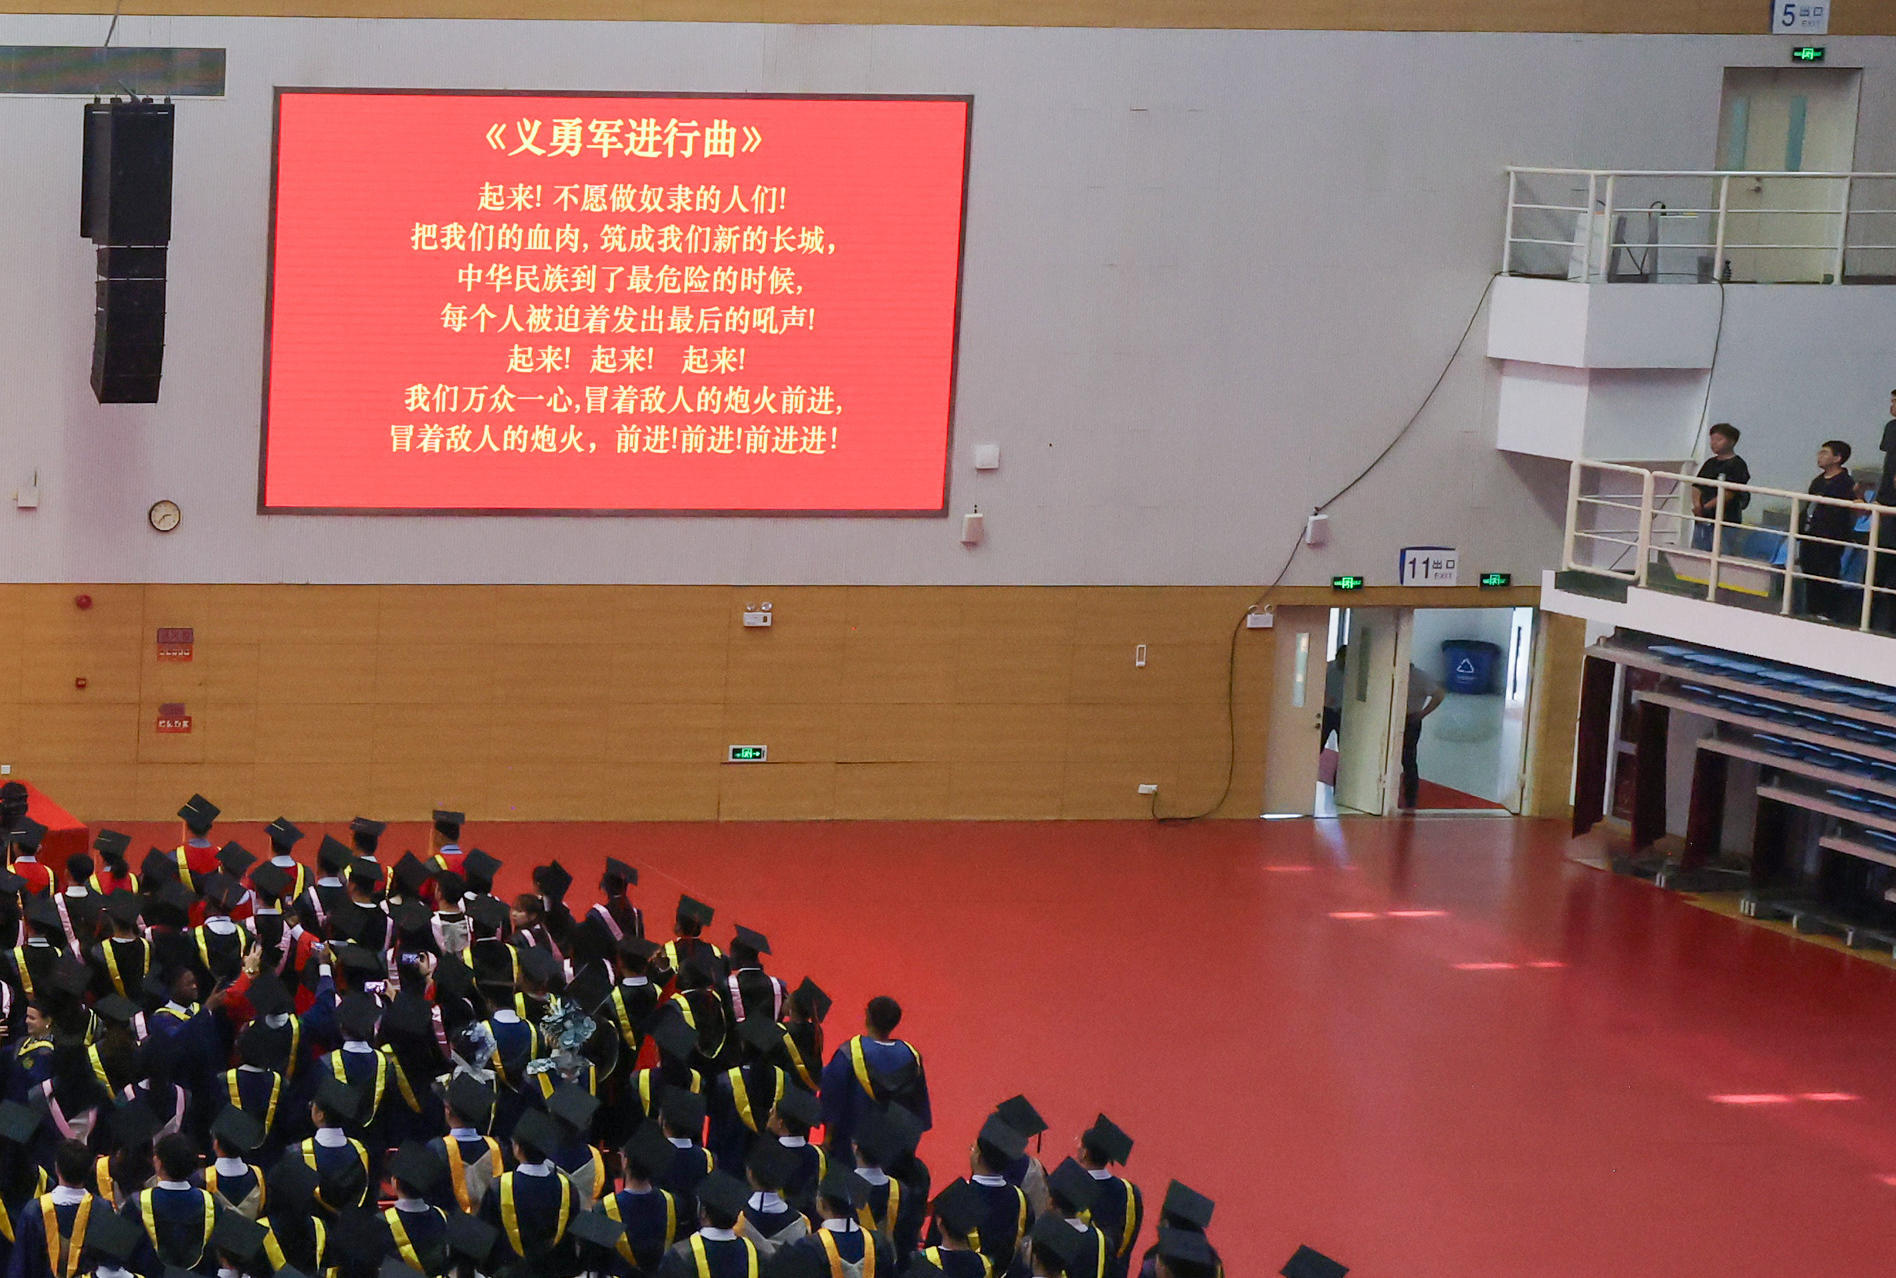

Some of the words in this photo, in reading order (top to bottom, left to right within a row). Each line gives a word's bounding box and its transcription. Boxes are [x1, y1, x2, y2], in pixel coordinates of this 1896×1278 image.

[1781, 4, 1796, 27] 5
[485, 116, 764, 159] 《义勇军进行曲》
[552, 182, 787, 215] 不愿做奴隶的人们!
[440, 302, 816, 335] 每个人被迫着发出最后的吼声!
[506, 343, 572, 374] 起来!
[589, 344, 655, 374] 起来!
[681, 344, 747, 375] 起来!
[1408, 557, 1430, 579] 11
[1432, 559, 1455, 569] 出口
